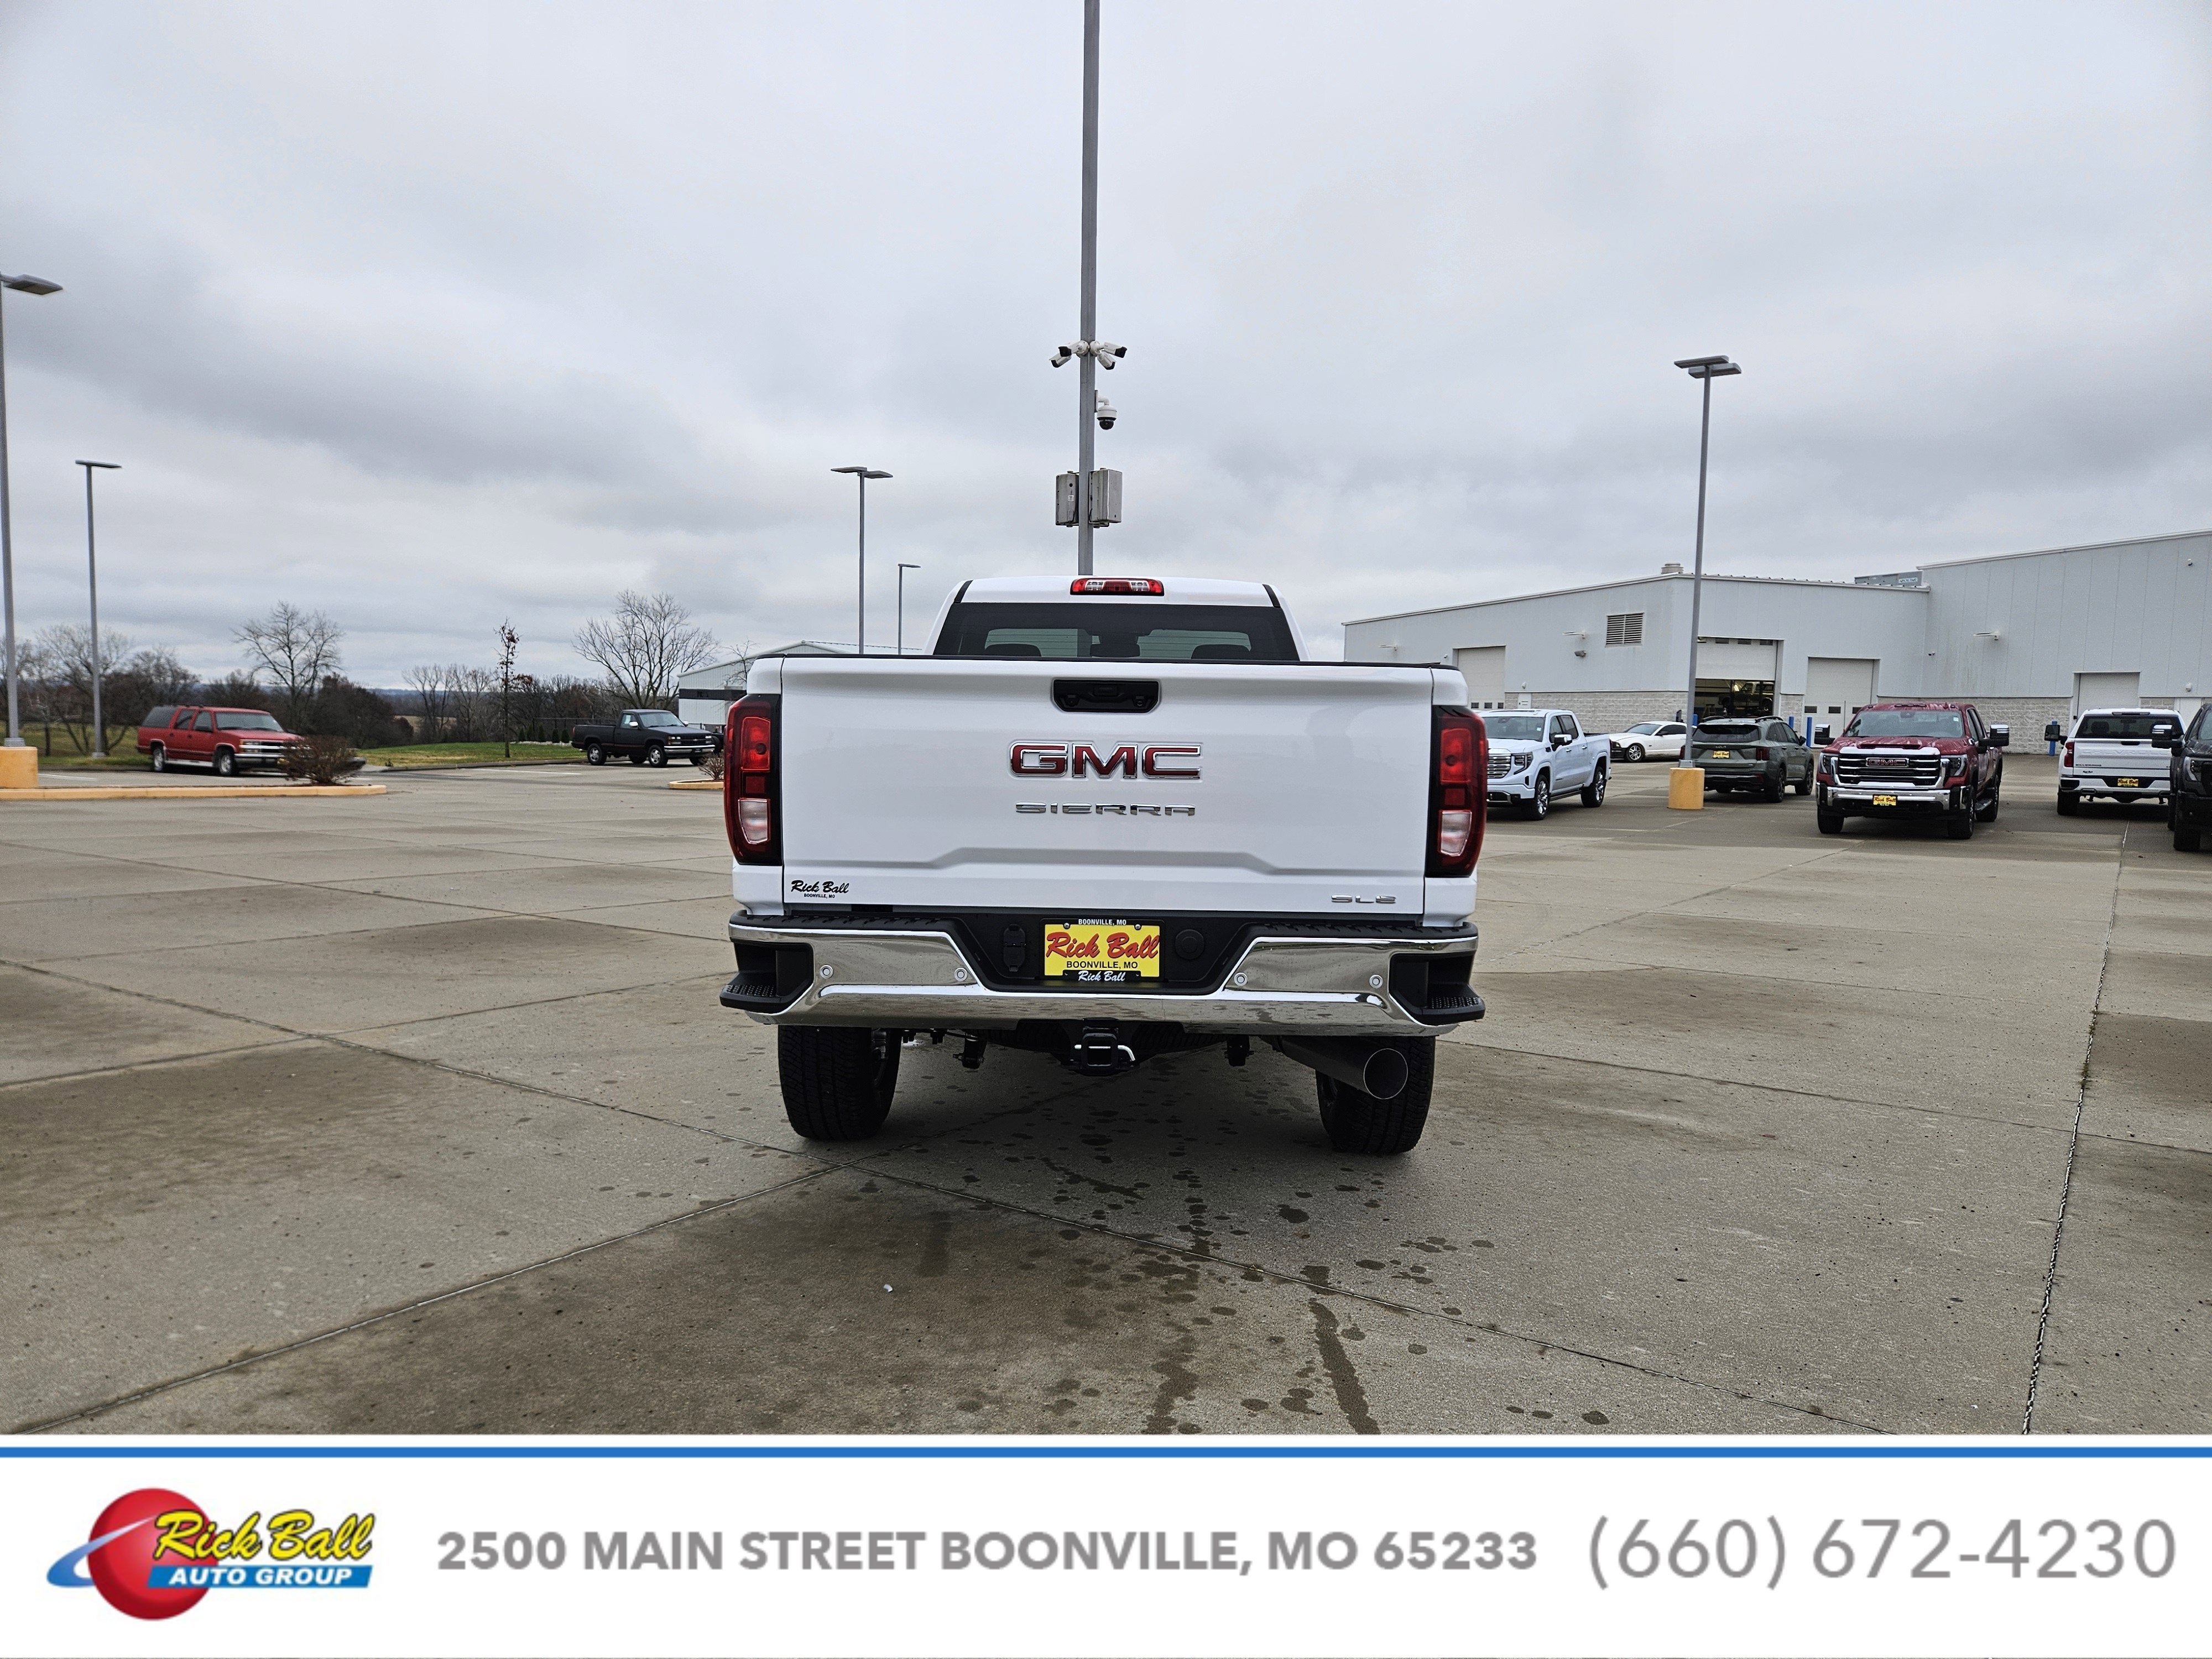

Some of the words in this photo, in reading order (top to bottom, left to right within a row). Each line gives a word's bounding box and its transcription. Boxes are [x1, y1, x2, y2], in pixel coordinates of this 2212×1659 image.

[1010, 742, 1202, 779] GMC
[1015, 801, 1196, 816] SIERRA
[791, 880, 820, 893] Rick
[822, 881, 849, 894] Ball
[1331, 895, 1396, 904] SLE
[1045, 931, 1100, 958] Rick
[1107, 932, 1160, 959] Ball
[1066, 961, 1121, 969] BOONVILLE,
[1078, 970, 1102, 982] Rick
[1103, 971, 1126, 982] Ball
